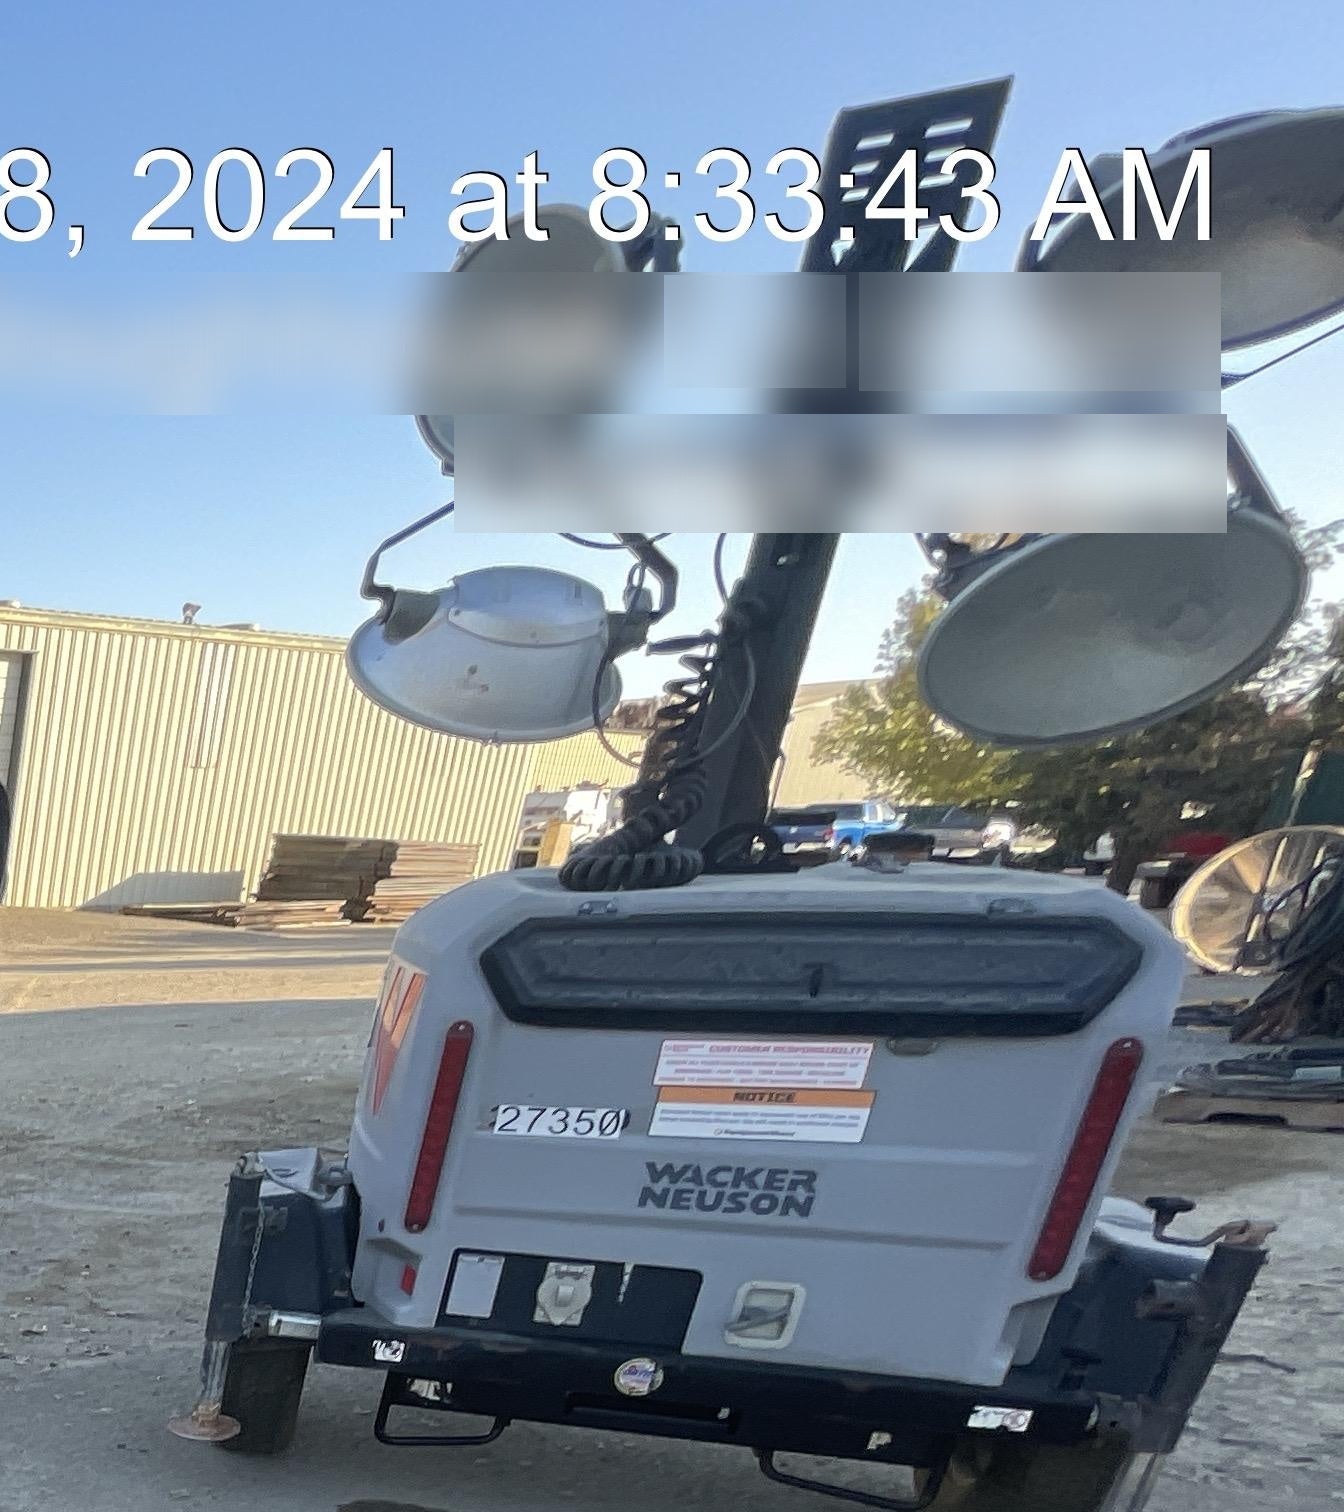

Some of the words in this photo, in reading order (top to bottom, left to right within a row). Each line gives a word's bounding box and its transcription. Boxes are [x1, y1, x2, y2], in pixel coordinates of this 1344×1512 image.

[733, 1091, 796, 1103] NOTICE
[497, 1106, 620, 1136] 27350
[645, 1161, 817, 1193] WACKER
[637, 1186, 814, 1218] NEUSON
